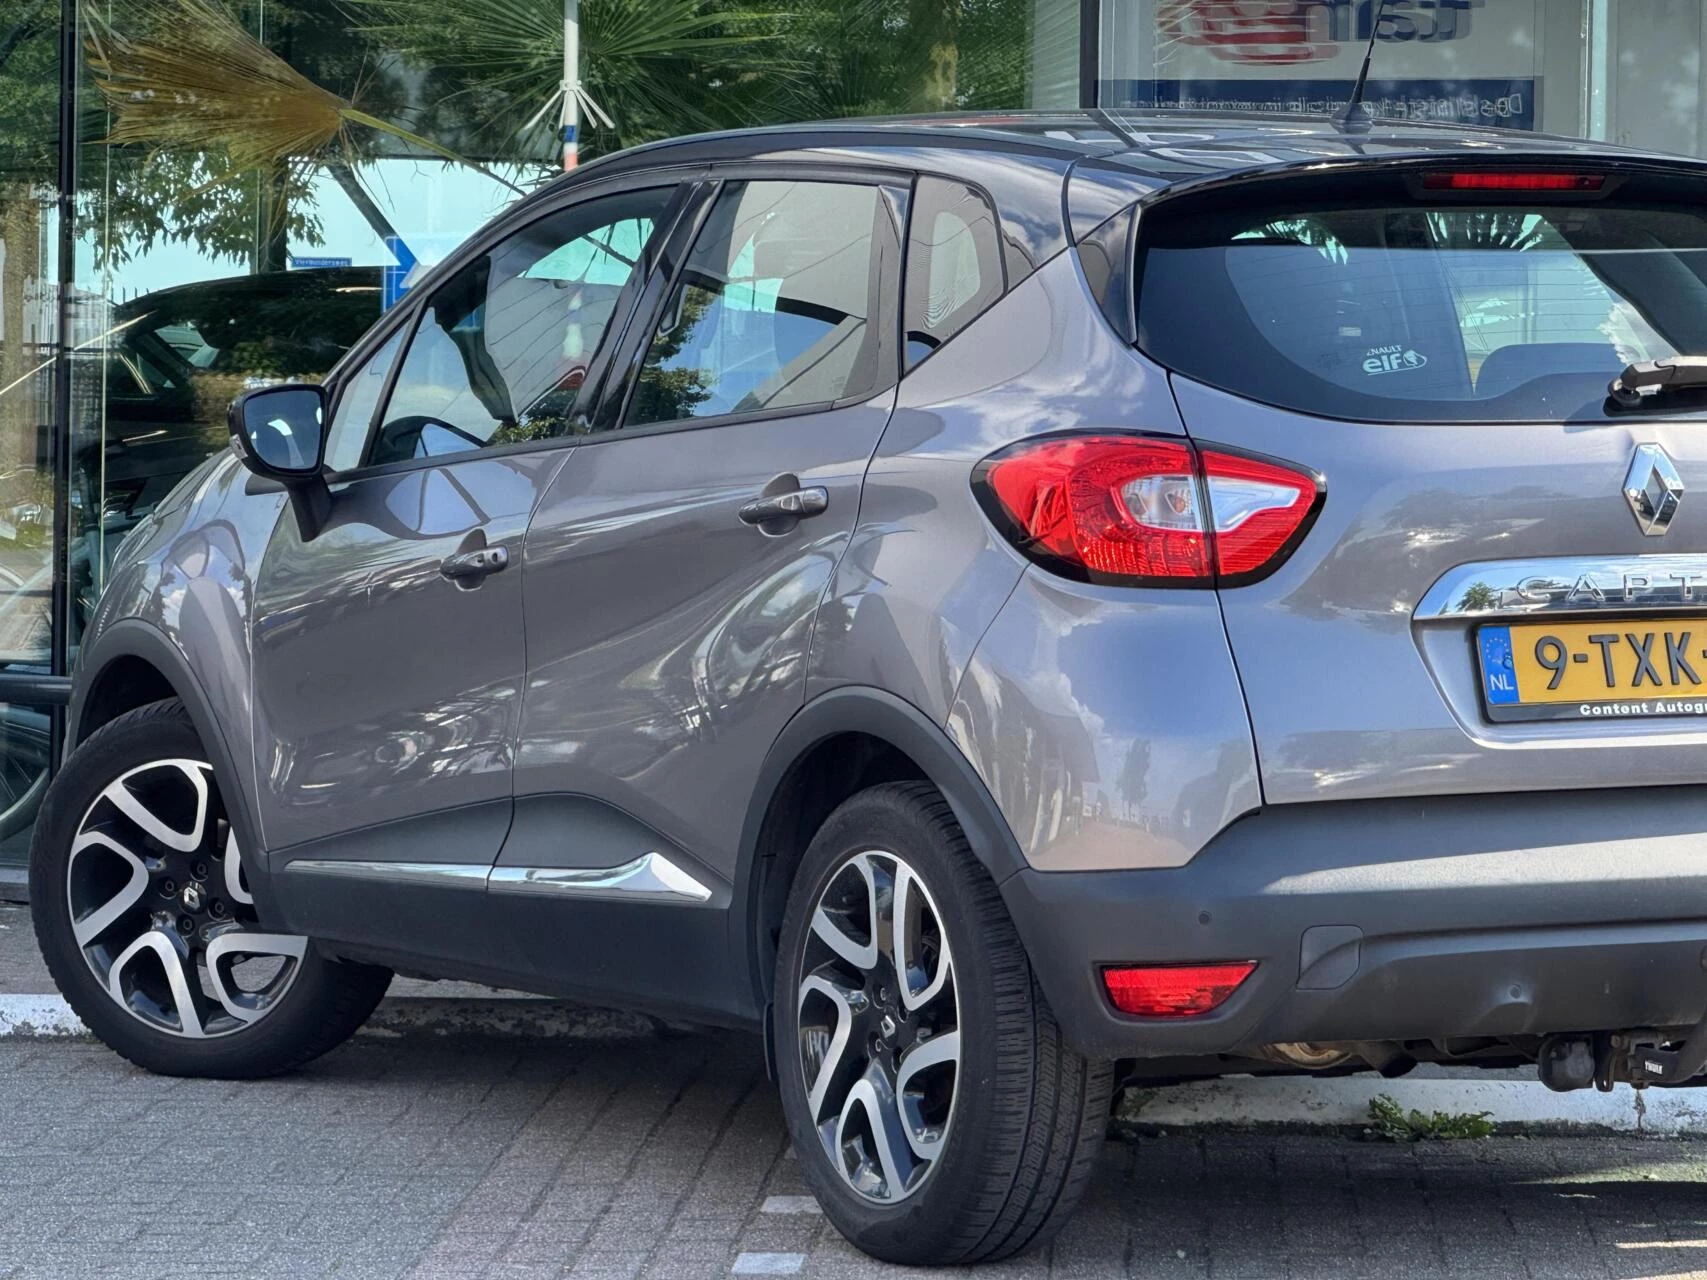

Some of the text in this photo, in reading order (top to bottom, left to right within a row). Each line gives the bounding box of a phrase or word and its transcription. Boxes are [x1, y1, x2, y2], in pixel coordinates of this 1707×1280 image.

[1363, 354, 1401, 373] elf
[1516, 573, 1703, 601] CAPT
[1490, 674, 1514, 690] NL
[1580, 702, 1649, 716] Content
